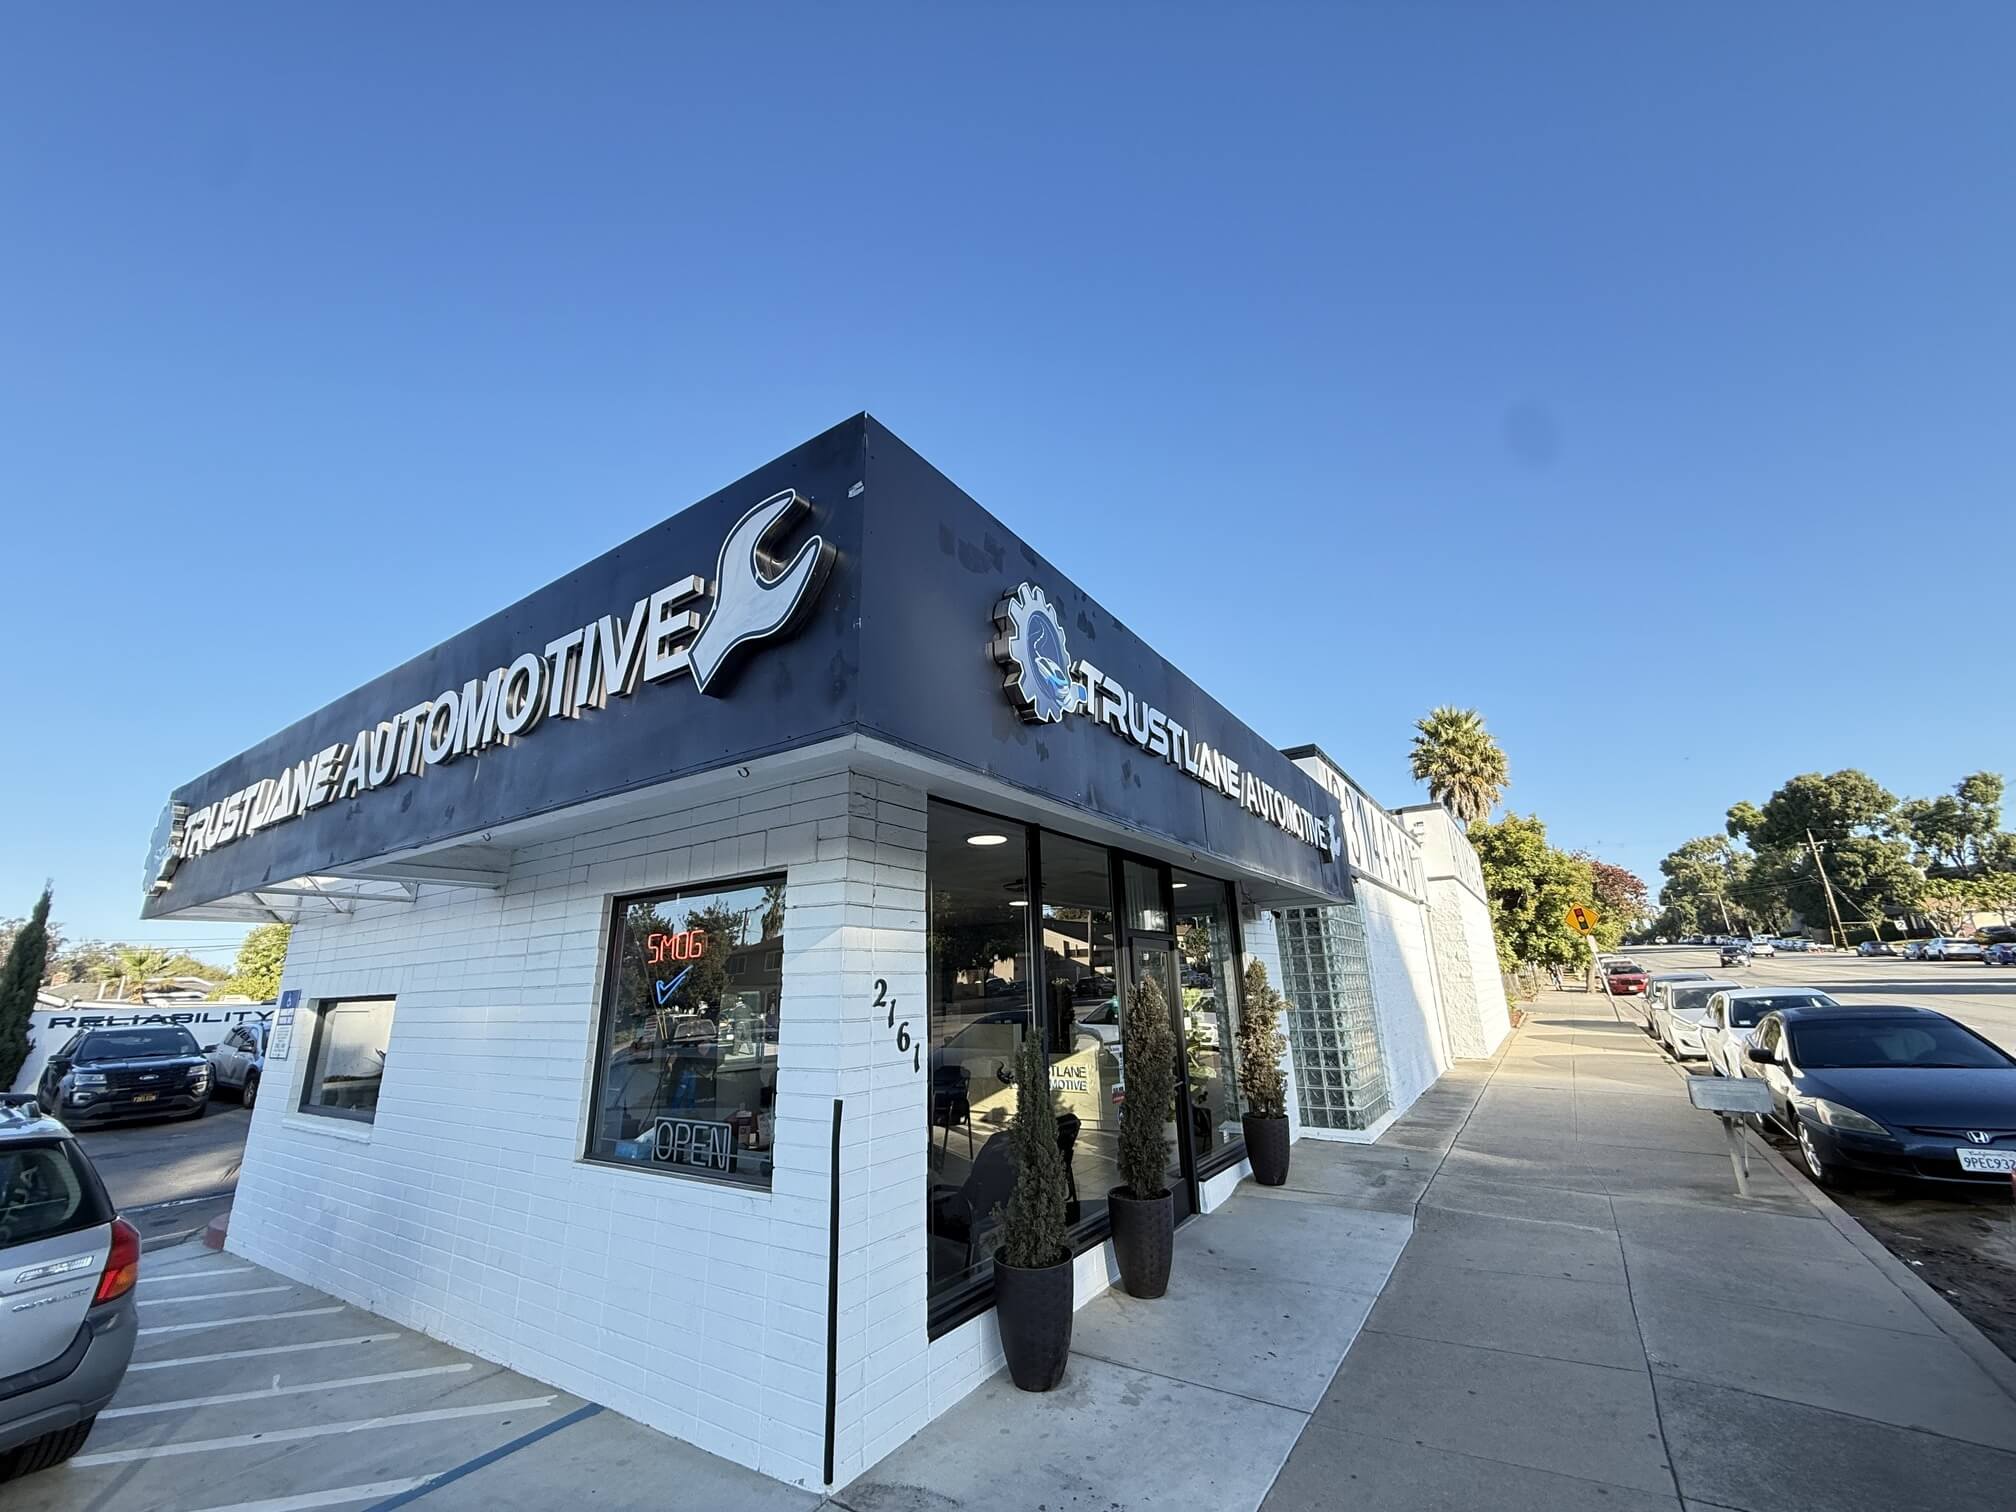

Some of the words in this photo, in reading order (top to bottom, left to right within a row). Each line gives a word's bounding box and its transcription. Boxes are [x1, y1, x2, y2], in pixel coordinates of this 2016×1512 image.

[179, 743, 347, 858] TRUSTLANE
[339, 575, 704, 799] AUTOMOTIVE
[1079, 659, 1240, 799] TRUSTLANE
[1241, 772, 1328, 850] AUTOMOTIVE
[648, 930, 704, 964] SMOG
[48, 1011, 275, 1029] RELIABILITY
[873, 978, 920, 1073] 2161
[655, 1121, 730, 1169] OPEN
